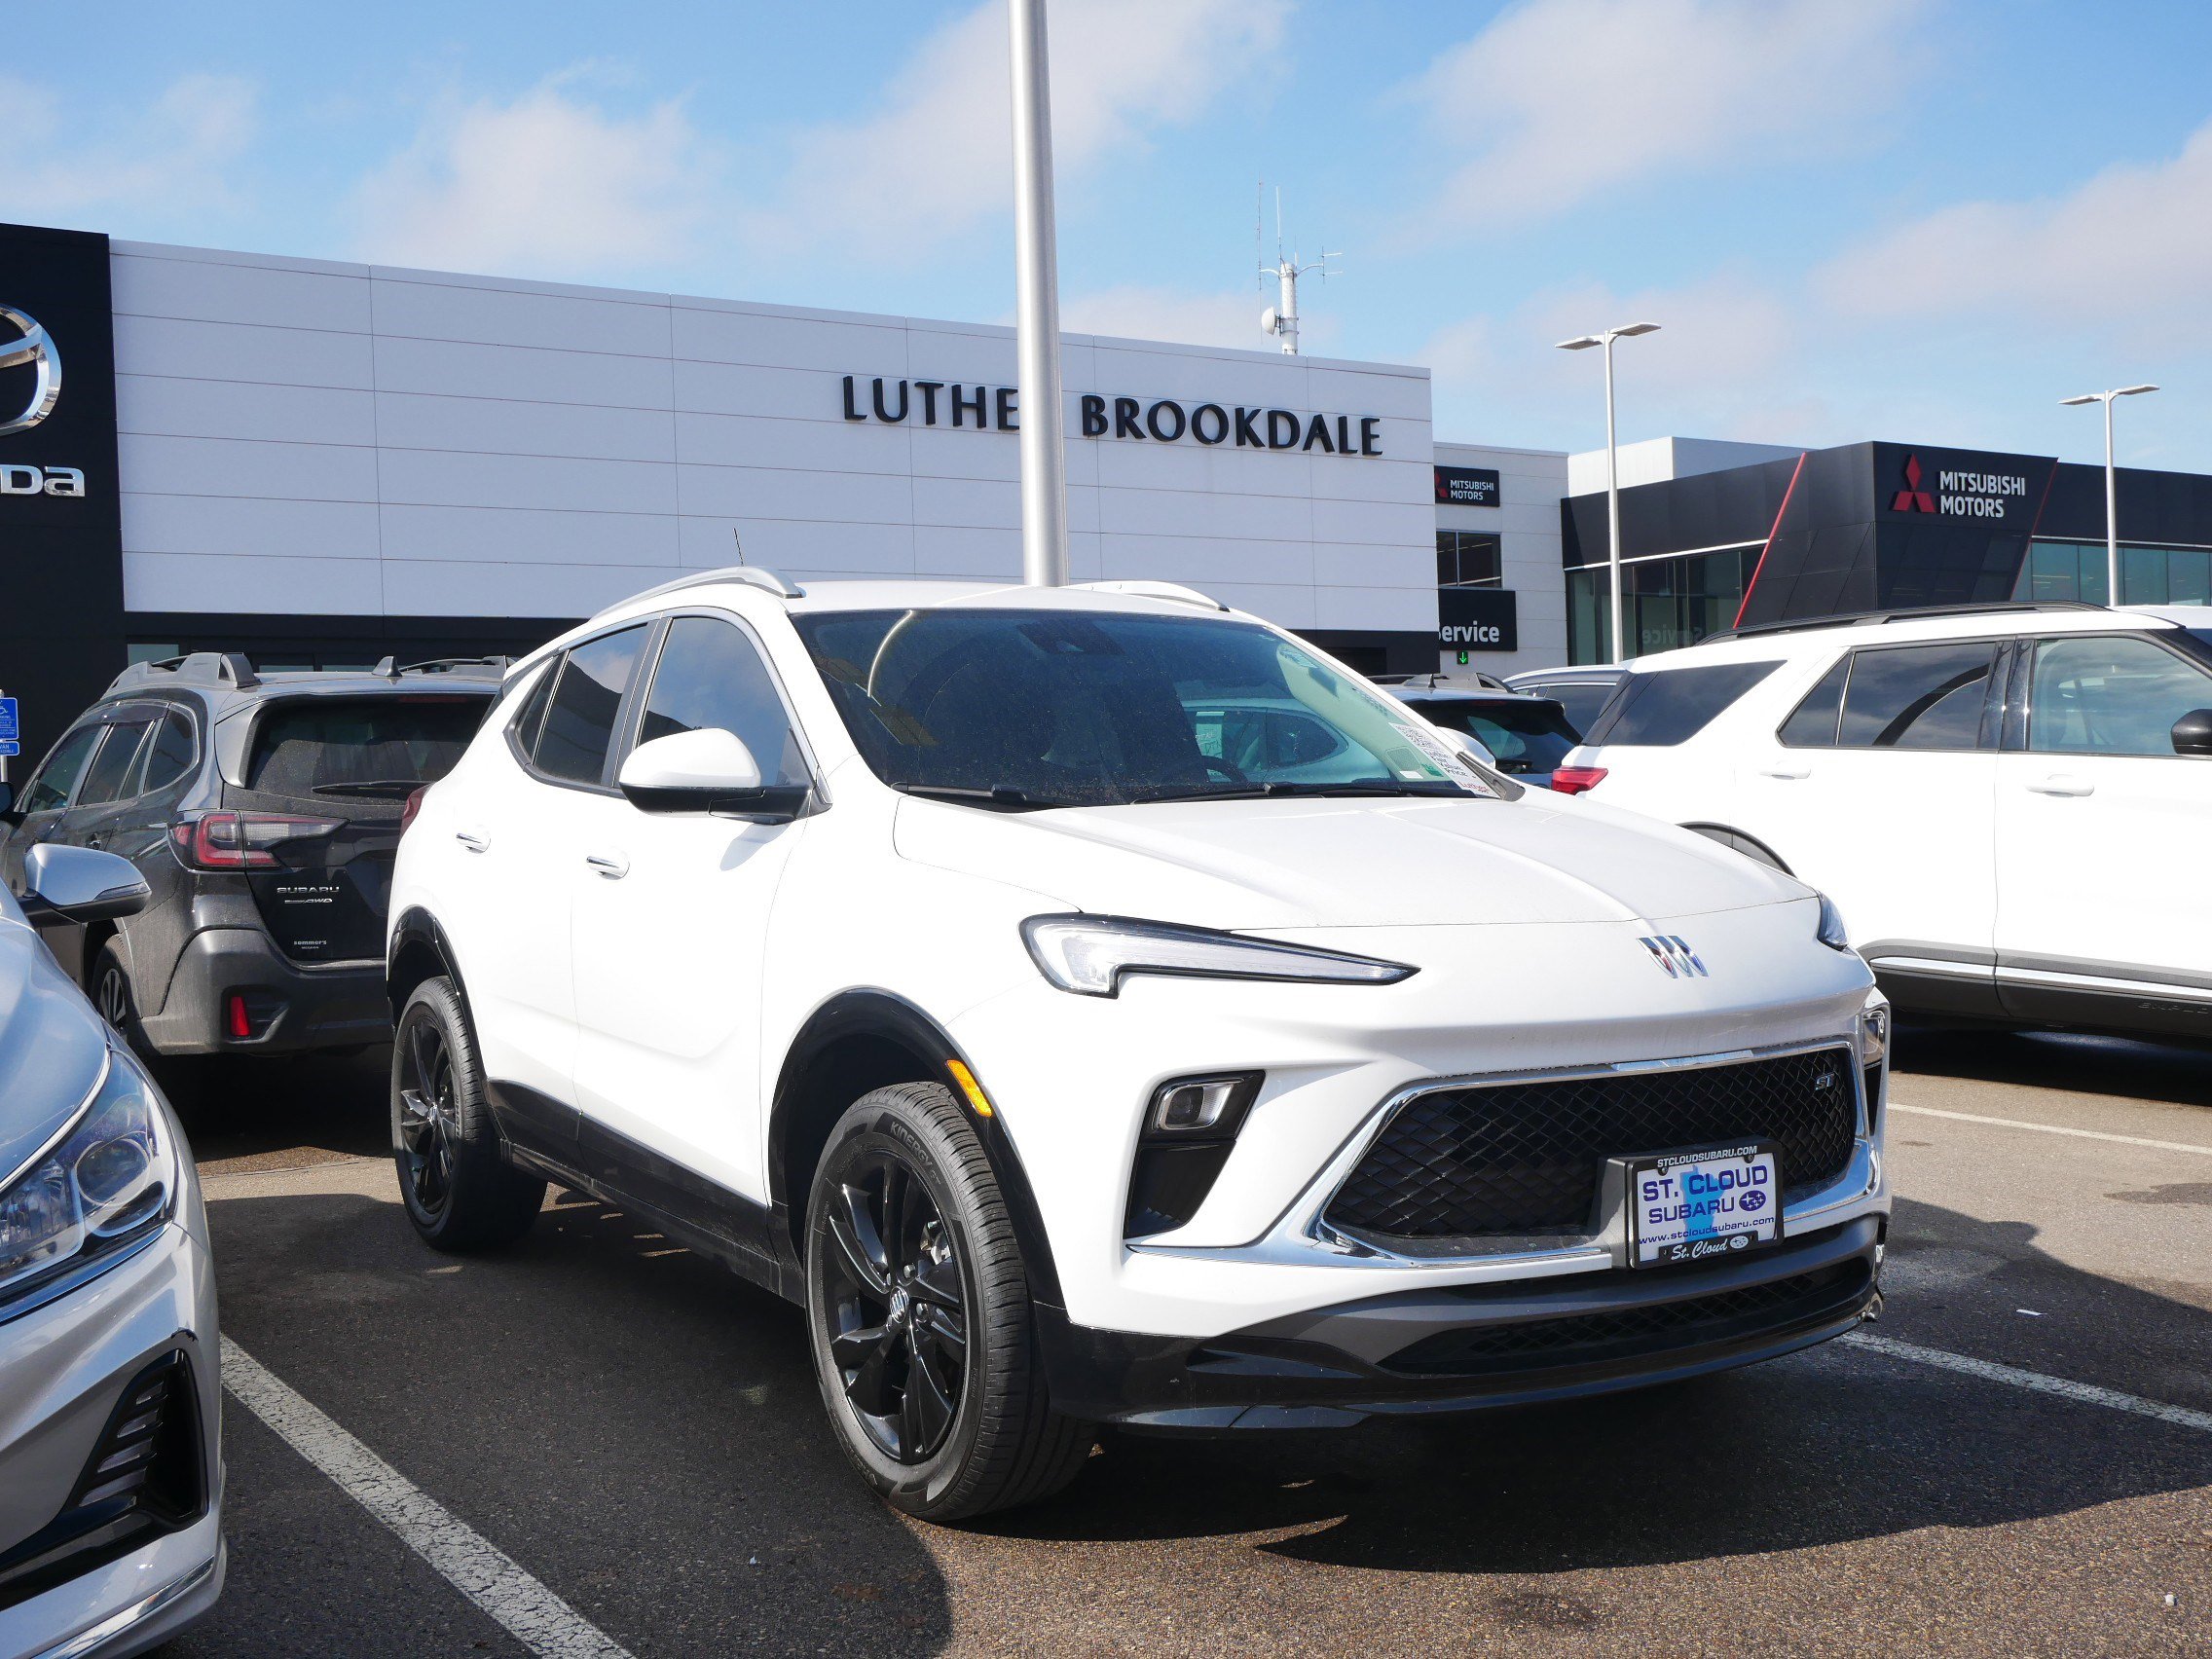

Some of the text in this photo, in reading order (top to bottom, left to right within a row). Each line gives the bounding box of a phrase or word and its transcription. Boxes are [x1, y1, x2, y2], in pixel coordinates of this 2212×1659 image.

[843, 376, 1382, 456] LUTHE BROOKDALE
[1450, 480, 1494, 491] MITSUBISHI
[1451, 490, 1483, 500] MOTORS
[1939, 471, 2025, 496] MITSUBISHI
[1940, 496, 2004, 518] MOTORS
[1439, 620, 1499, 642] ervice
[1657, 1145, 1757, 1168] STCLOUDSUBARU.COM
[1642, 1165, 1767, 1201] ST. CLOUD
[1648, 1197, 1735, 1224] SUBARU
[1639, 1217, 1775, 1244] www.stcloudsubaru.com
[1671, 1238, 1728, 1261] St. Cloud
